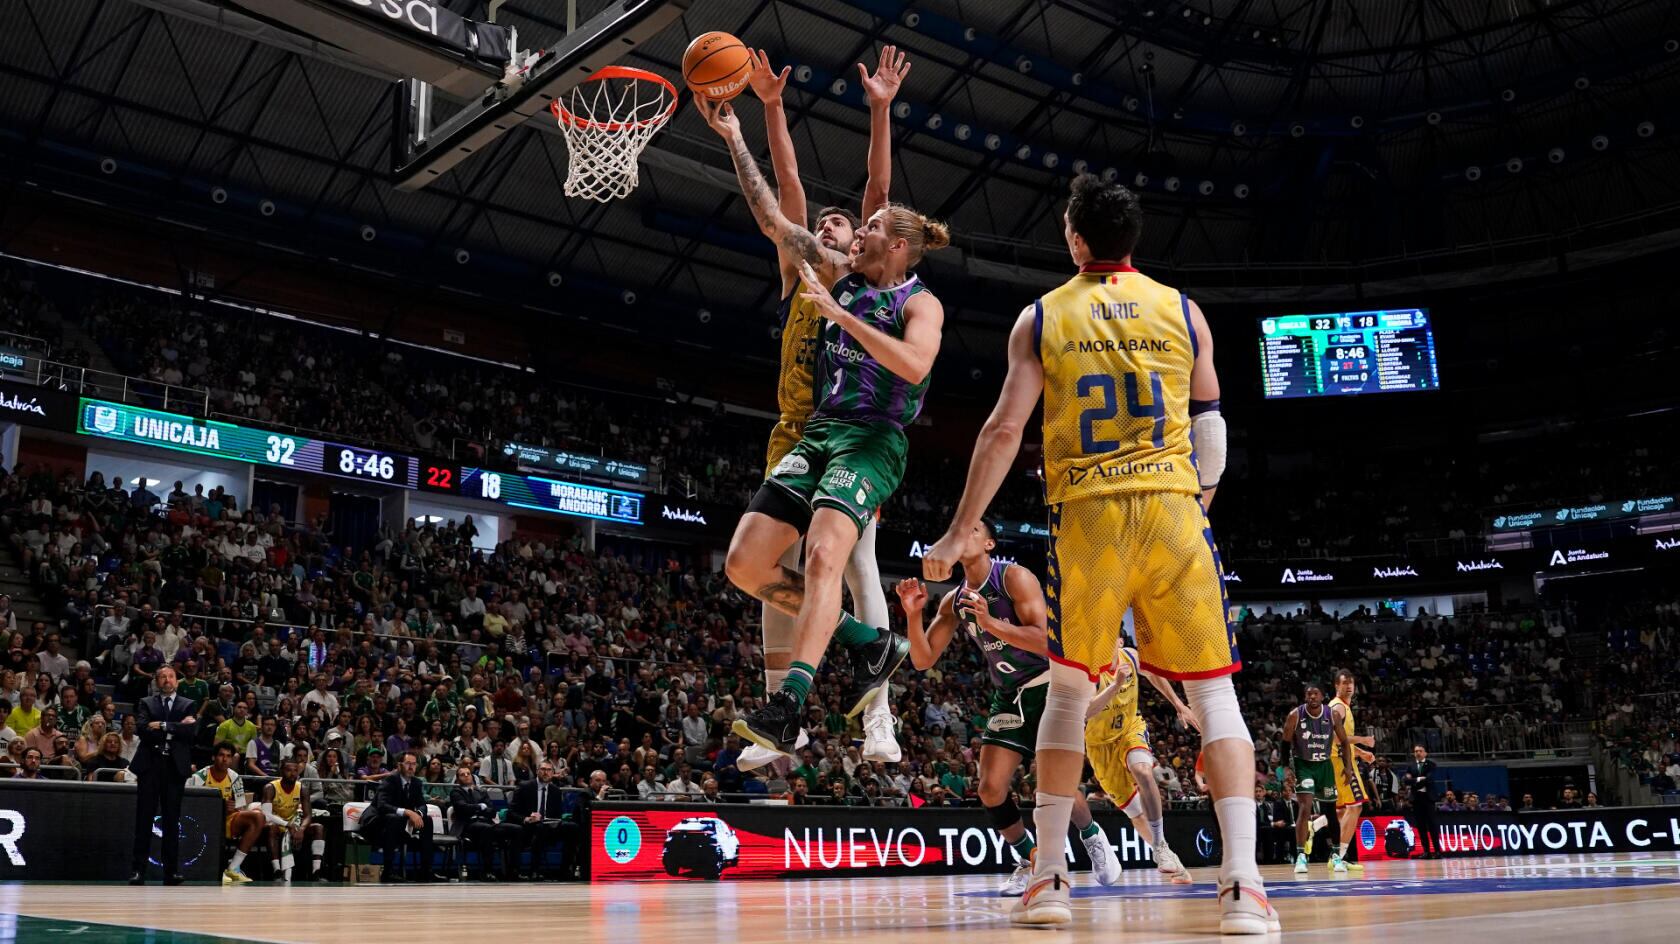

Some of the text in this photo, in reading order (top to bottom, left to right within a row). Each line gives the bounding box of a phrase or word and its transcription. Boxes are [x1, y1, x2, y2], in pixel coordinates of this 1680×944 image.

[1090, 302, 1140, 320] KURIC
[1315, 319, 1330, 330] 32
[1337, 317, 1351, 328] VS
[1359, 316, 1374, 327] 18
[1079, 339, 1172, 353] MORABANC
[1336, 347, 1365, 360] 8:46
[831, 367, 843, 395] 1
[1075, 371, 1166, 454] 24
[134, 415, 220, 450] UNICAJA
[266, 435, 296, 465] 32
[339, 449, 395, 480] 8:46
[1092, 462, 1174, 479] Andorra
[427, 467, 451, 488] 22
[480, 472, 501, 500] 18
[550, 483, 609, 505] MORABANC
[1639, 496, 1674, 506] Fundación
[558, 497, 608, 517] ANDORRA
[1570, 504, 1607, 515] Fundación
[1638, 502, 1665, 513] Unicaja
[1507, 512, 1542, 522] Fundación
[1571, 511, 1598, 521] Unicaja
[1508, 519, 1534, 528] Unicaja
[1577, 551, 1609, 561] Andalucía
[1373, 565, 1418, 578] Andalucía
[1457, 560, 1503, 572] Andalucía
[1305, 573, 1333, 581] Andalucía
[1111, 714, 1124, 730] 13
[1312, 752, 1327, 761] 55
[617, 828, 628, 845] 0
[1497, 821, 1614, 851] TOYOTA
[784, 827, 926, 869] NUEVO
[939, 828, 1076, 866] TOY
